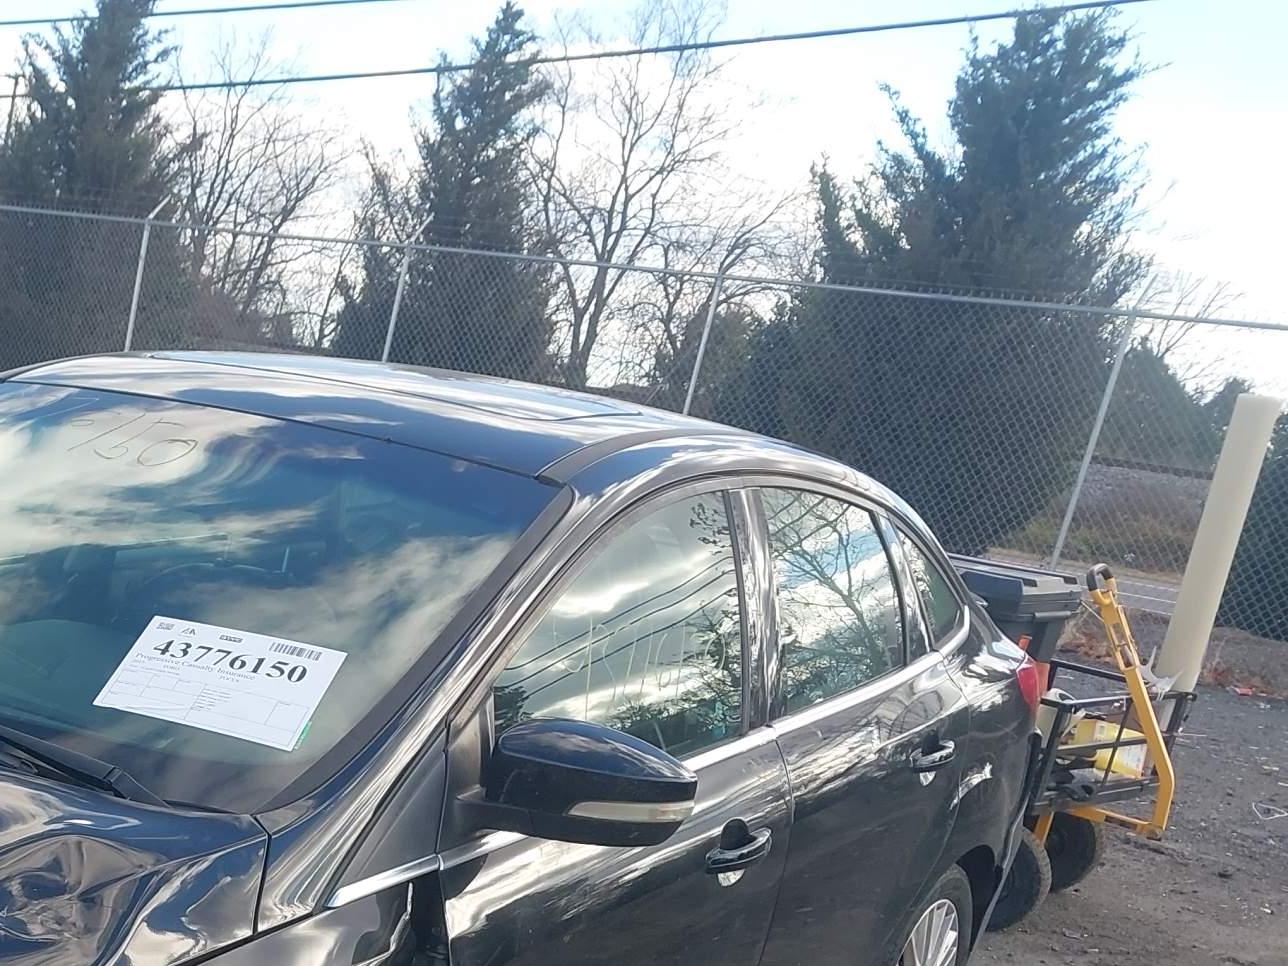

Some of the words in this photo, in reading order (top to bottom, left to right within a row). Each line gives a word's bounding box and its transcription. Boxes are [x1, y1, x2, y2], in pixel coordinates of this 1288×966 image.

[135, 651, 181, 665] Progressive
[182, 660, 213, 673] Casualty
[217, 667, 256, 681] Insurance
[153, 638, 308, 684] 43776150
